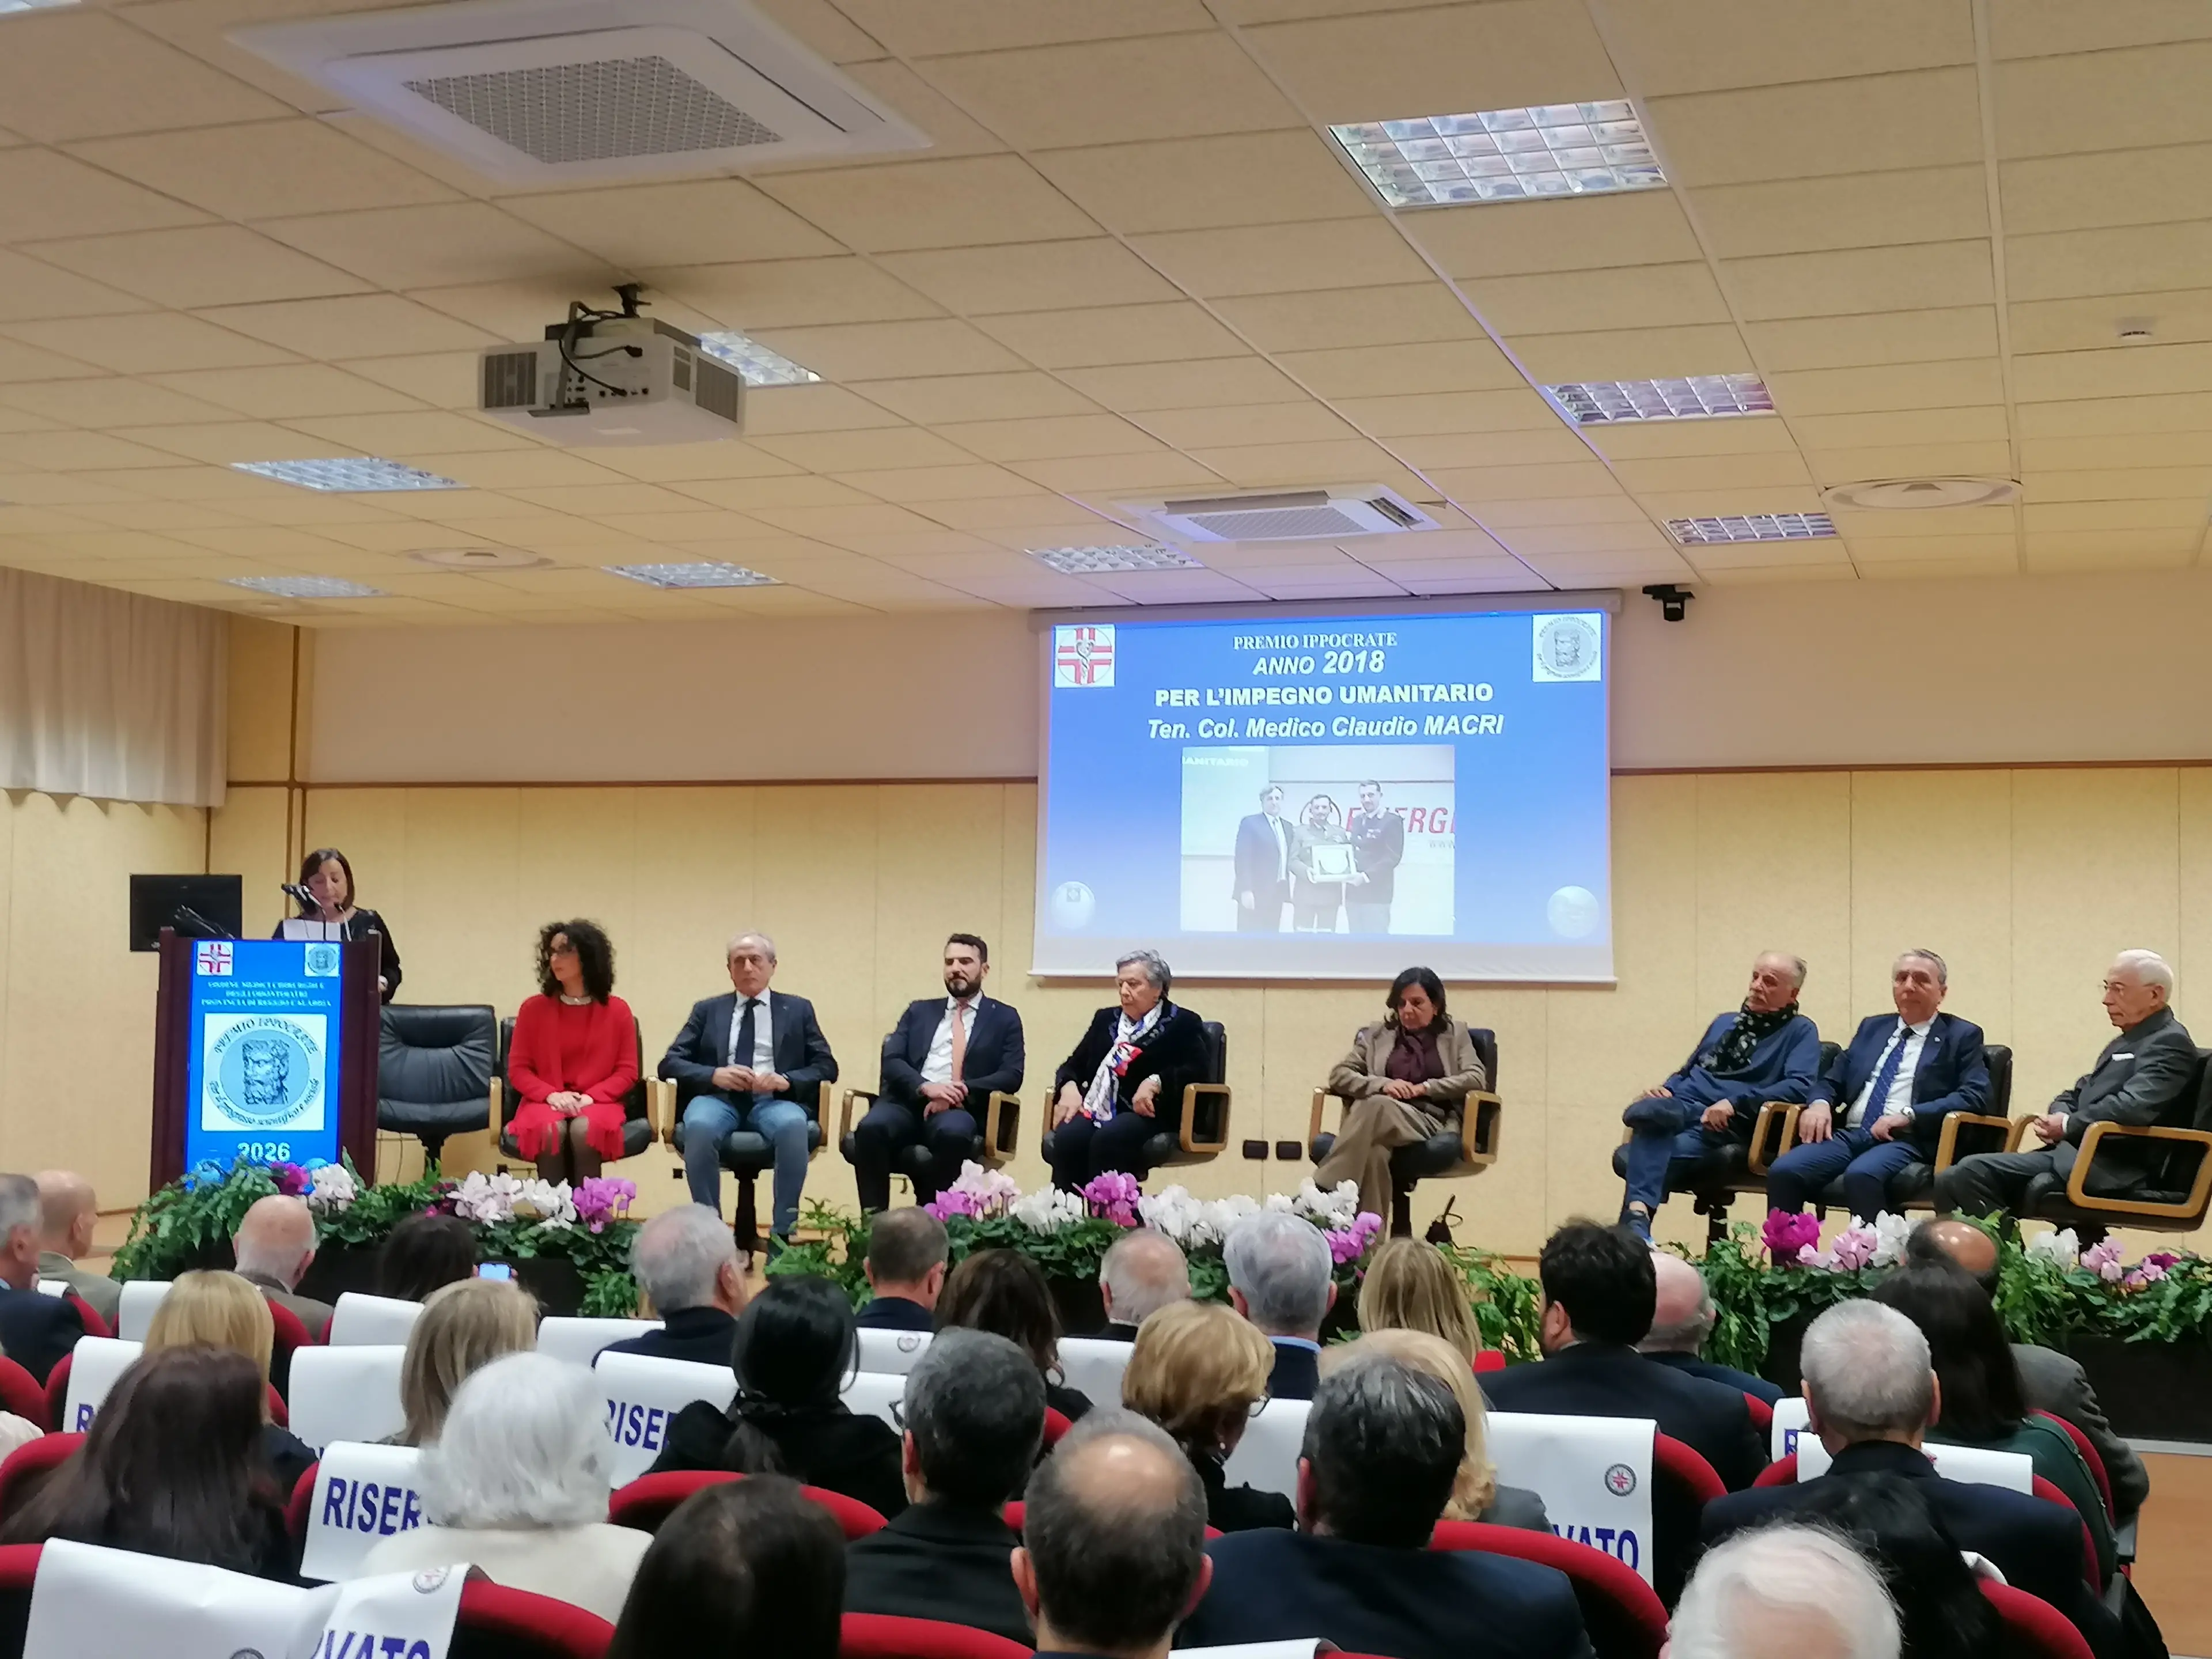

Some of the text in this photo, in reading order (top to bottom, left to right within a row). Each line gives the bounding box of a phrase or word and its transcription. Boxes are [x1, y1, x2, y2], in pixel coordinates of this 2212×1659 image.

[1233, 632, 1397, 650] PREMIO IPPOCRATE
[1252, 649, 1386, 676] ANNO 2018
[1154, 683, 1494, 707] PER L'IMPEGNO UMANITARIO
[1148, 714, 1505, 738] Ten. Col. Medico Claudio MACRI
[237, 1142, 290, 1162] 2026
